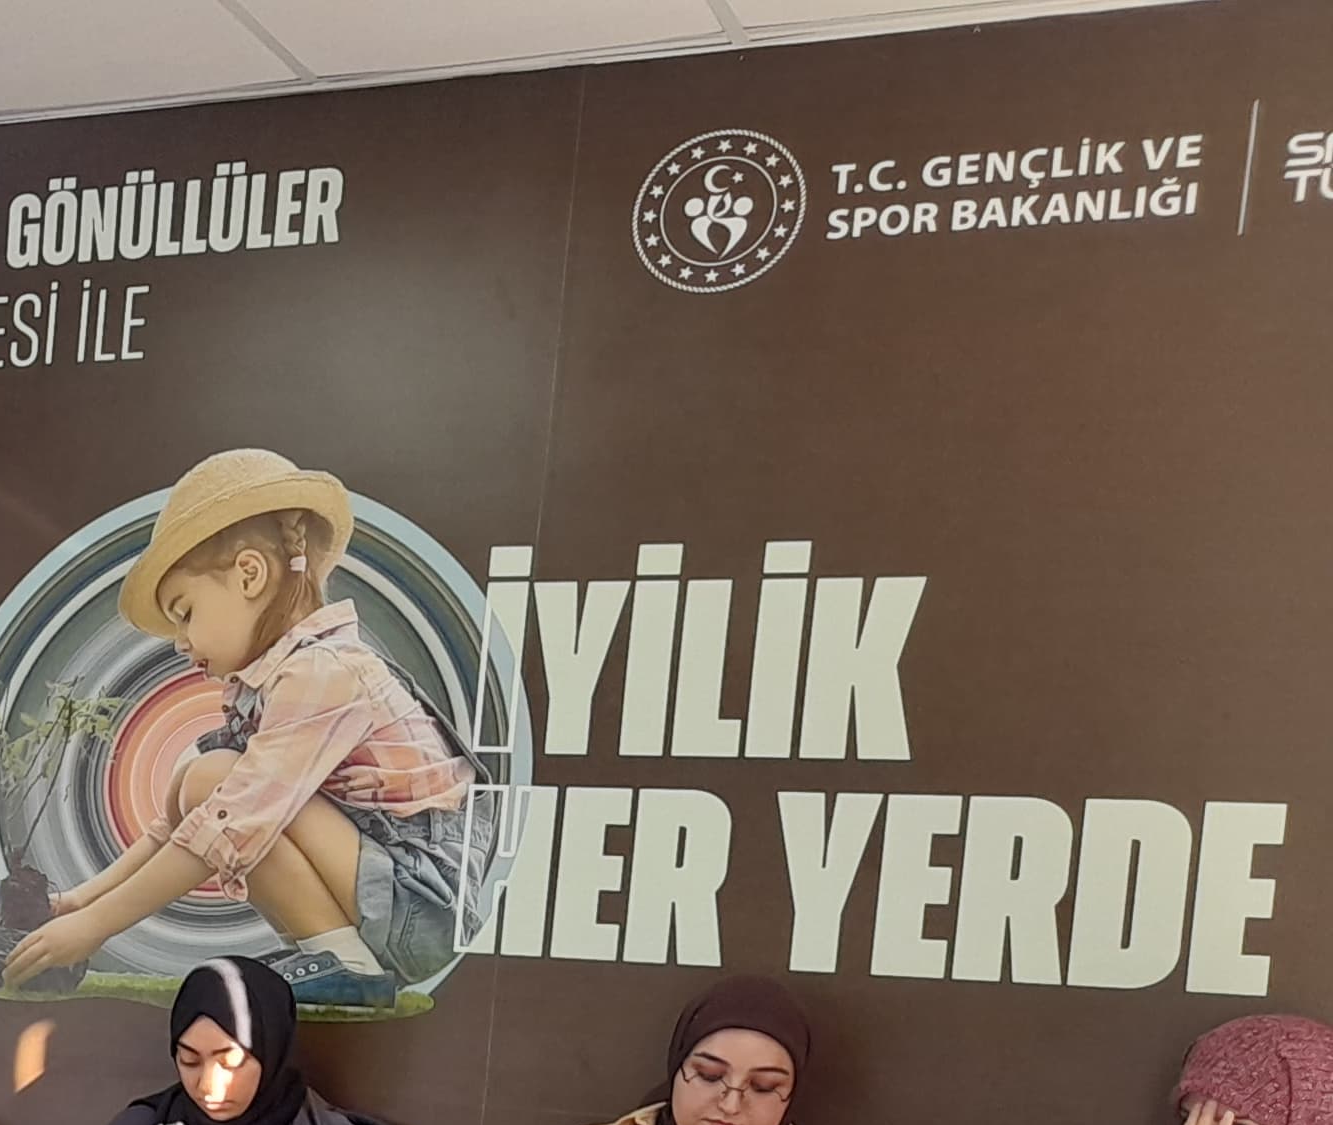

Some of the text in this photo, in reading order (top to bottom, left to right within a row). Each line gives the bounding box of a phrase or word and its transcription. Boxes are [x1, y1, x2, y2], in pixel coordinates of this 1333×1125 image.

[831, 134, 1203, 194] T.C. GENÇLİK VE
[1285, 131, 1333, 167] S
[6, 160, 344, 270] GÖNÜLLÜLER
[826, 176, 1198, 240] SPOR BAKANLIĞI
[77, 278, 150, 363] İLE
[473, 540, 928, 761] İYİLİK
[454, 784, 1288, 998] HER YERDE
